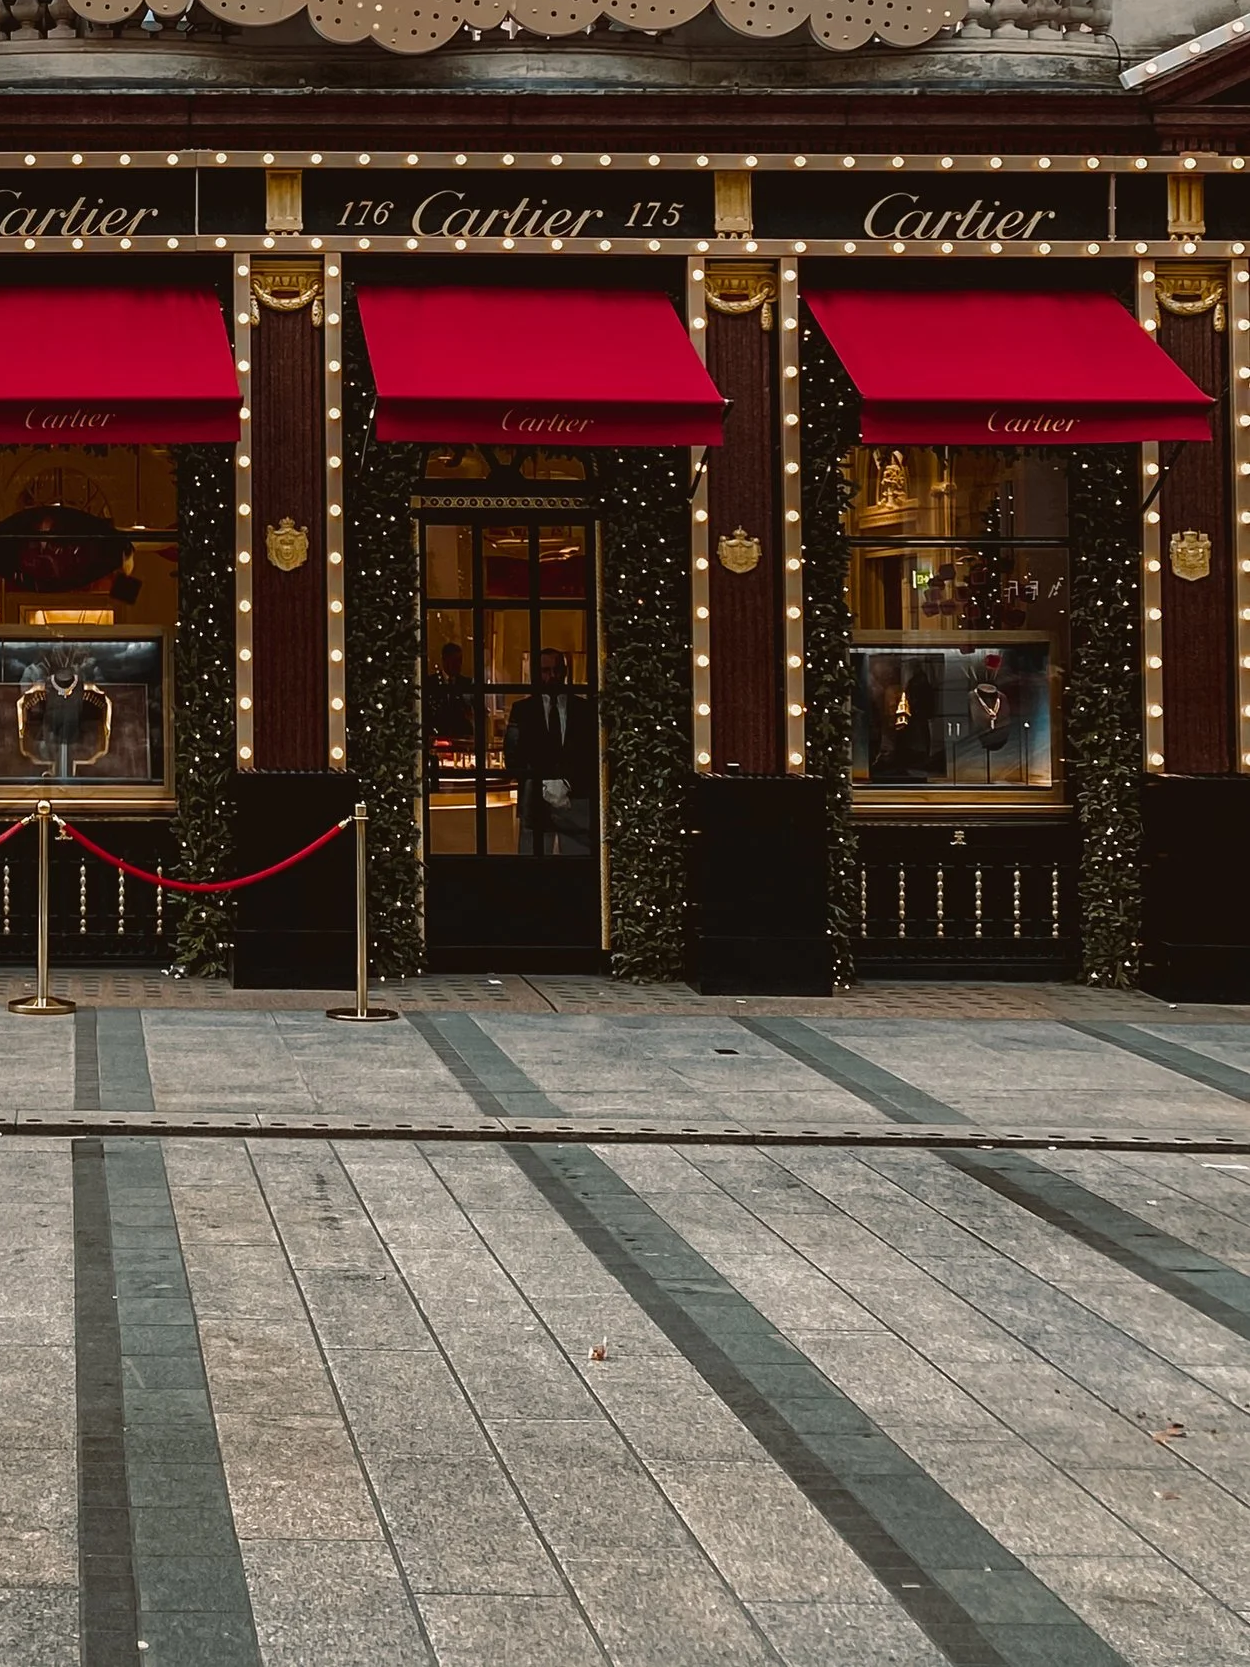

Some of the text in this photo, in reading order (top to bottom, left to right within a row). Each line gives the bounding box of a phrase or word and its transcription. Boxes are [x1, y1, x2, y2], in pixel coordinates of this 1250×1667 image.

[336, 190, 684, 237] 176 Cartier 175
[863, 192, 1056, 239] Cartier
[25, 407, 116, 430] Cartier
[501, 407, 595, 433] Cartier
[987, 409, 1081, 433] Cartier
